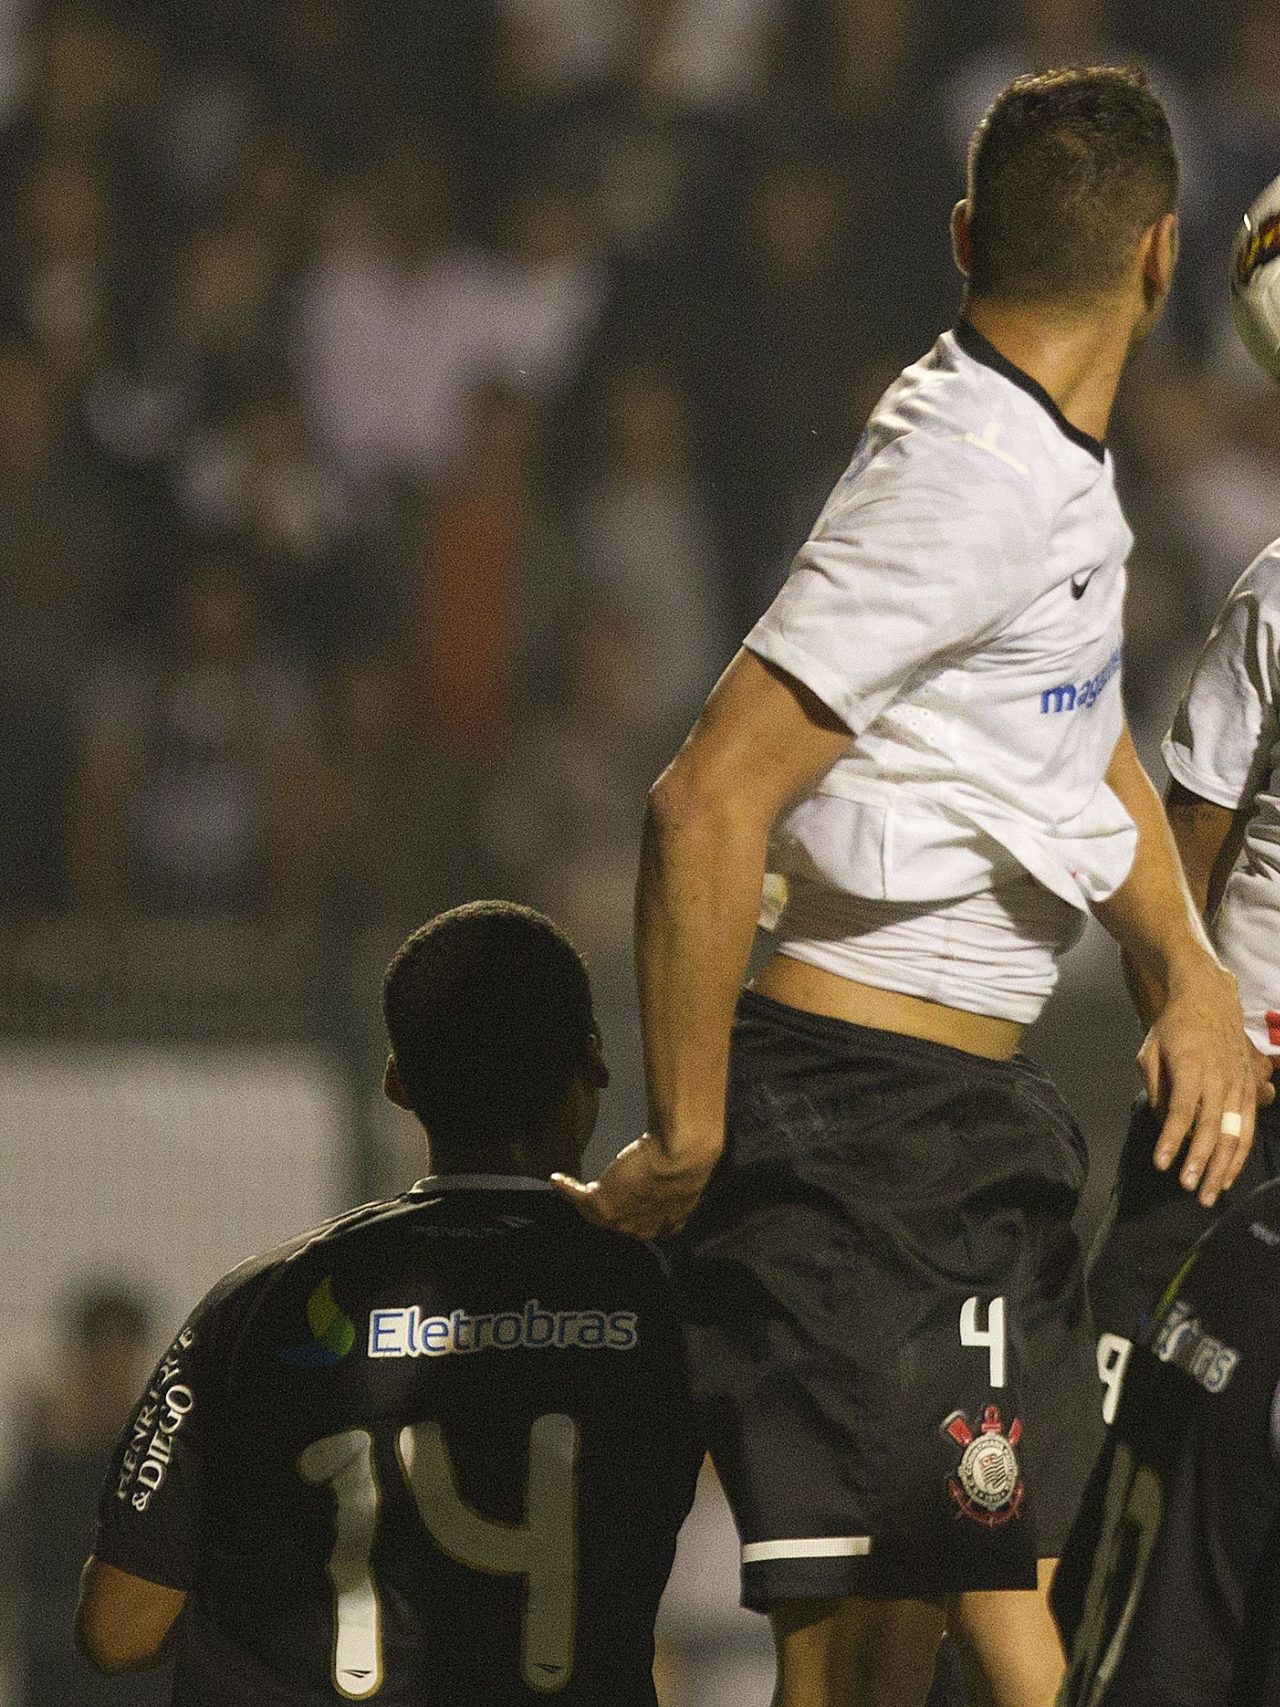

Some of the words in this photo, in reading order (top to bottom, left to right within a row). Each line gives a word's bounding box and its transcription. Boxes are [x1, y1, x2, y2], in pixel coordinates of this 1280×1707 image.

[368, 1300, 638, 1357] Eletrobras
[960, 1297, 1004, 1388] 4
[298, 1412, 581, 1699] 14
